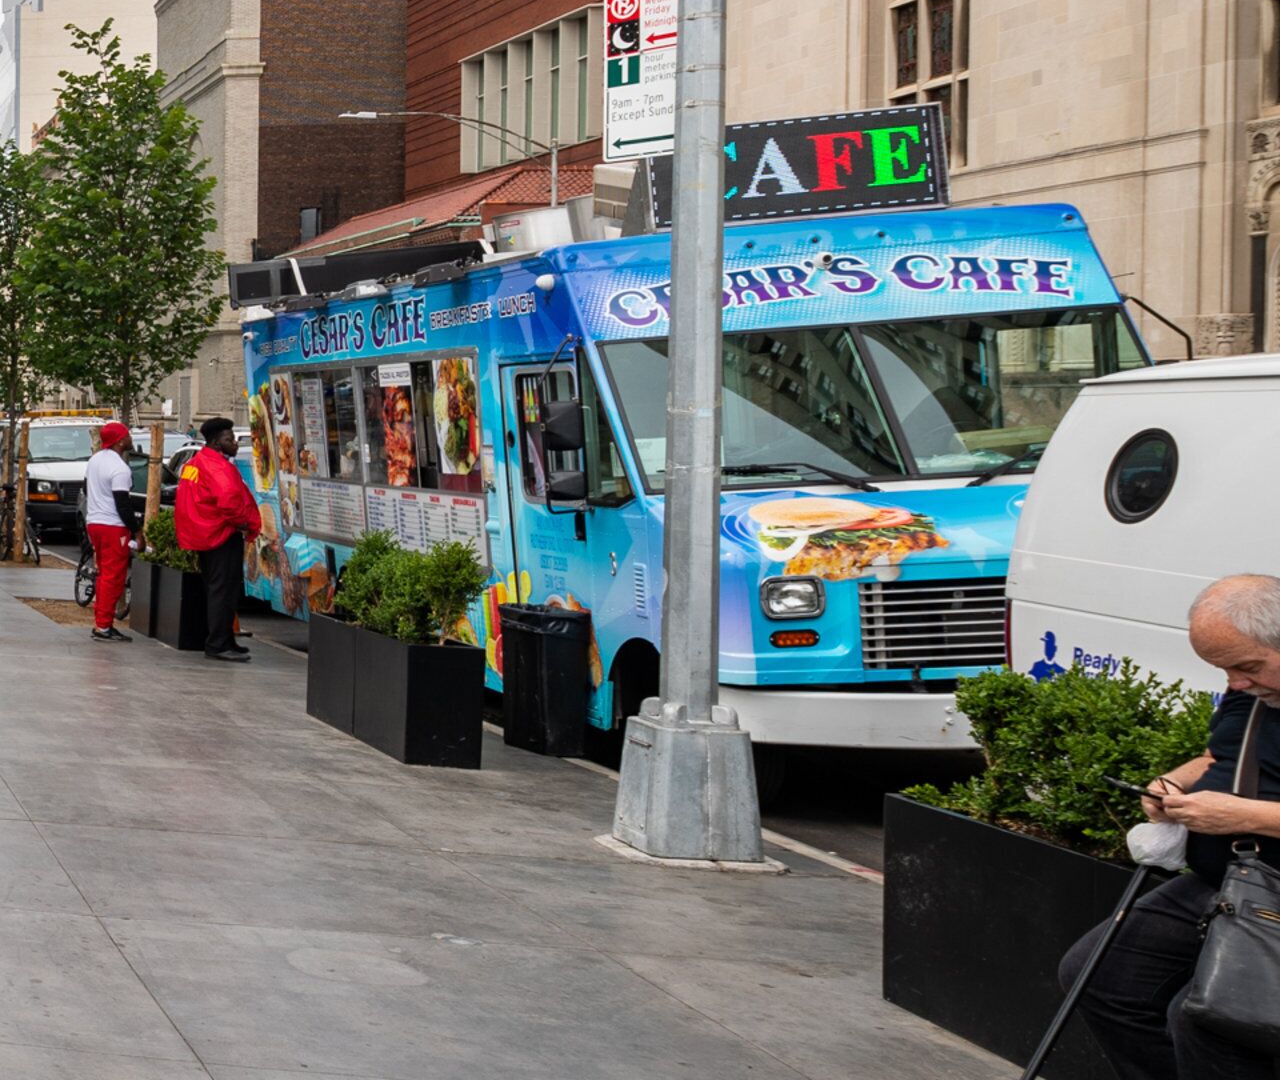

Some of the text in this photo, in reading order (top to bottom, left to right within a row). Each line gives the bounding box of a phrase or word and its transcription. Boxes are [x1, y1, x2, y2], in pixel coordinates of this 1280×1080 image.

[644, 6, 671, 16] Friday
[644, 15, 678, 28] Midnigh
[644, 54, 664, 63] hour
[644, 62, 676, 72] metere
[618, 57, 629, 84] 1
[611, 99, 633, 109] 9am
[643, 93, 664, 105] 7pm
[611, 104, 674, 122] Except Sund
[889, 251, 1075, 301] CAFE
[300, 309, 366, 360] CESAR'S
[370, 294, 428, 350] CAFE
[497, 292, 537, 318] LUNCH
[1073, 646, 1121, 677] Ready
